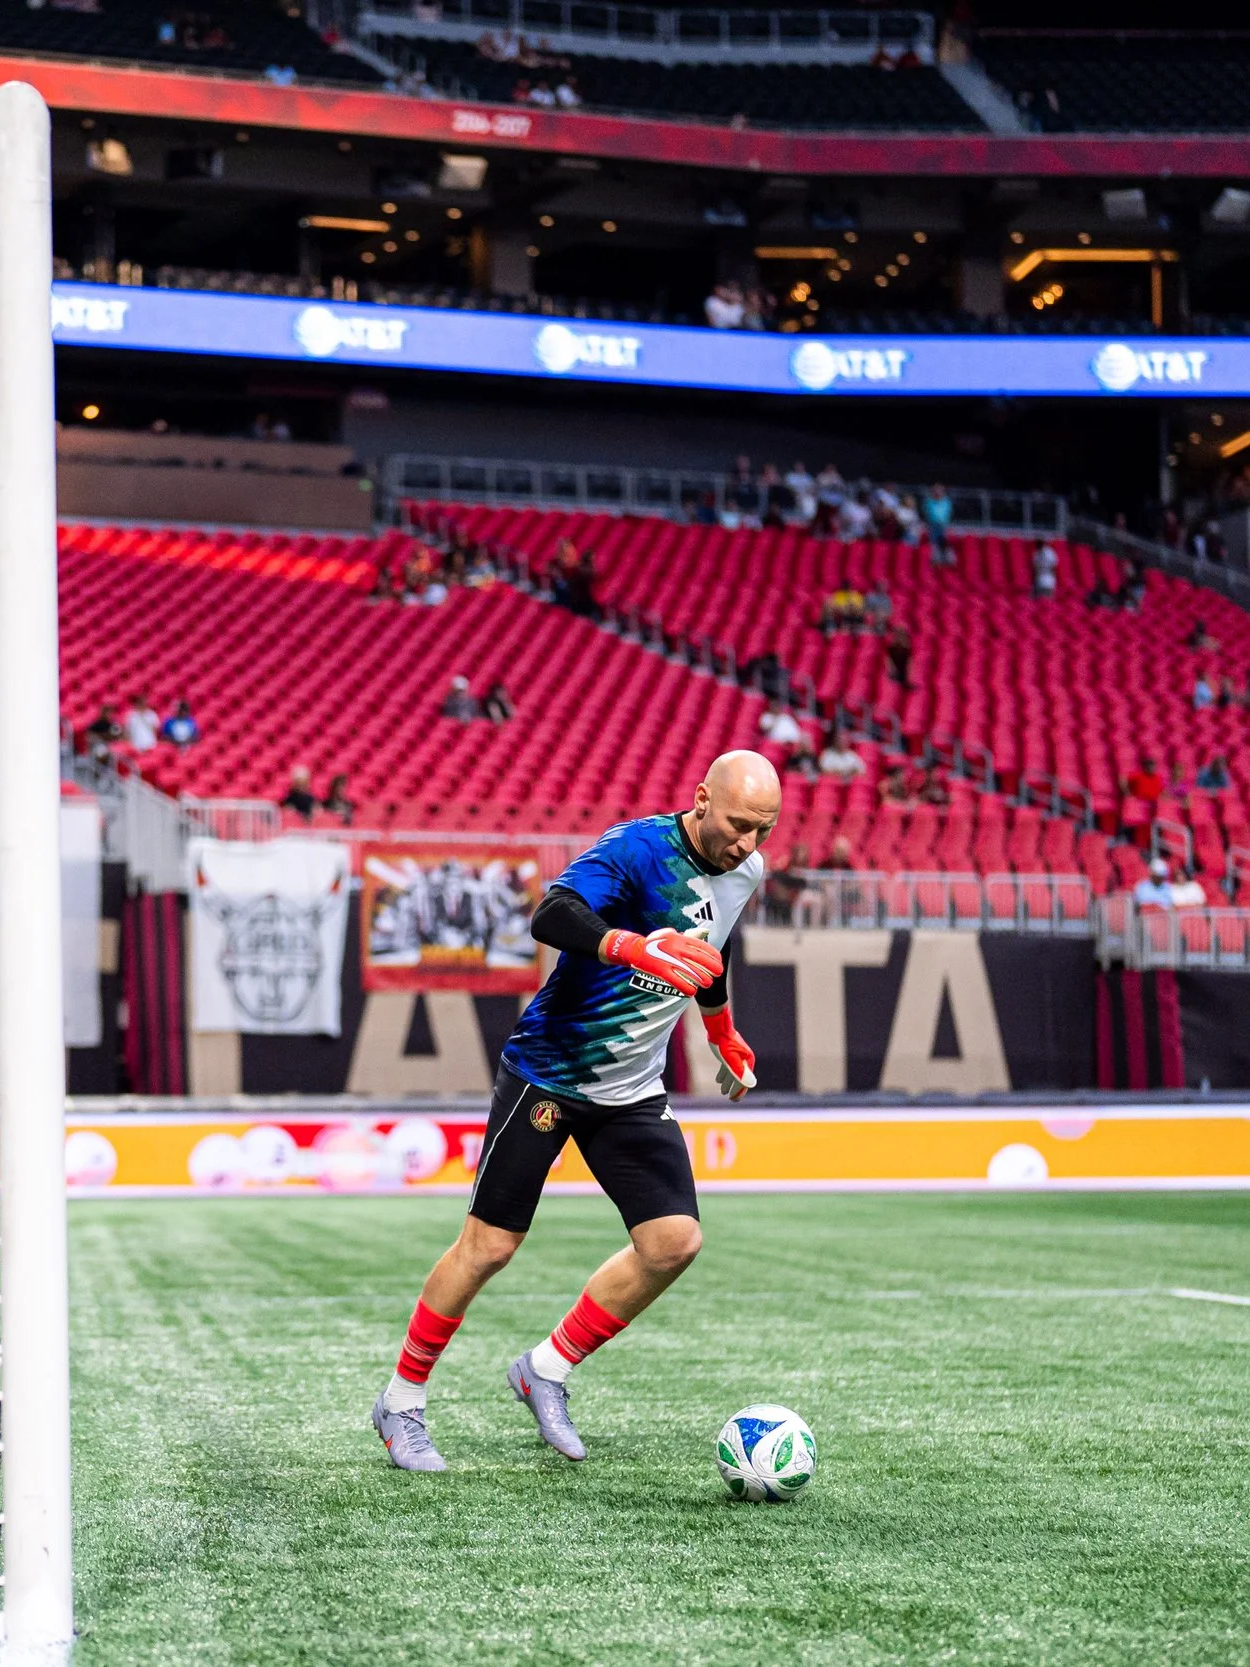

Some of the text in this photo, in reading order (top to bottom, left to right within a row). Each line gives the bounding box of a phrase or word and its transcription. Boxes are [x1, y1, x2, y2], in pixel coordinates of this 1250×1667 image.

[833, 349, 908, 381] AT&T
[1134, 350, 1209, 382] AT&T
[639, 979, 686, 997] INSUR
